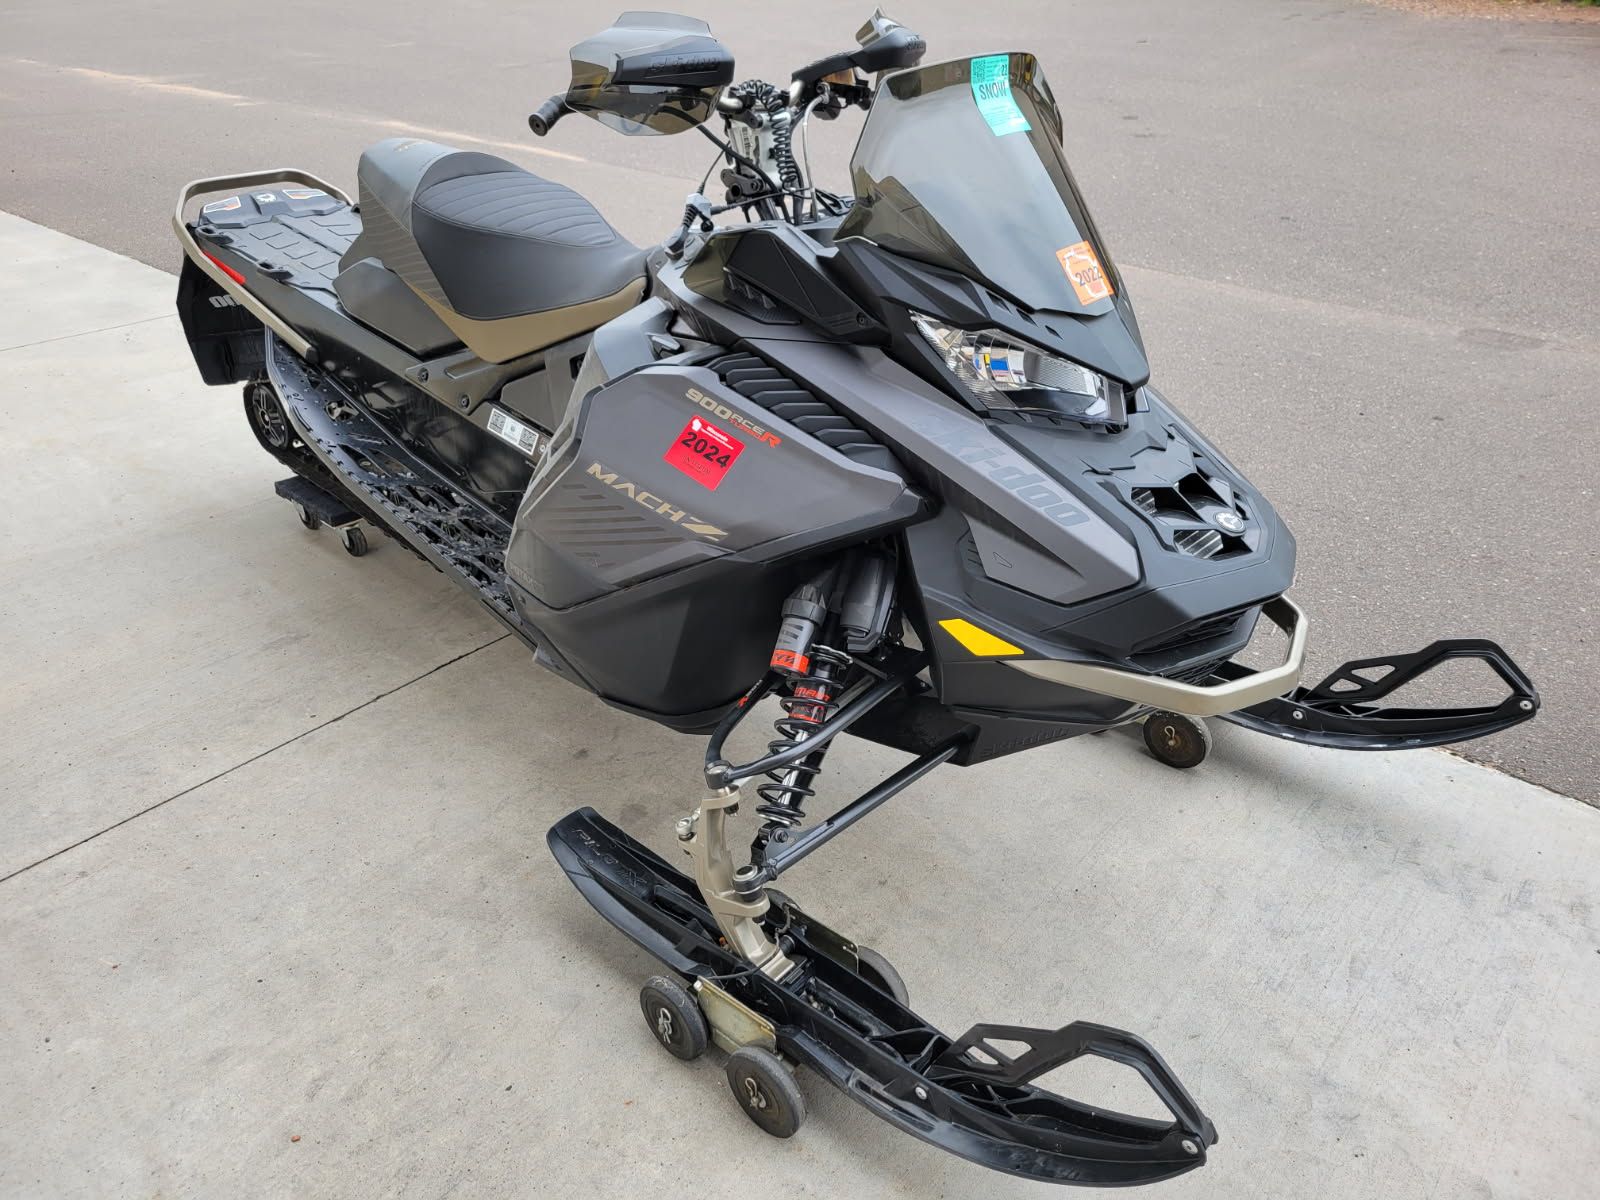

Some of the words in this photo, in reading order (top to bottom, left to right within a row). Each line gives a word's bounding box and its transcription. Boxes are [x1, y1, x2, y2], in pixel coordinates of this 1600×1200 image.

[979, 80, 1007, 101] SNOW
[1075, 267, 1104, 287] 2022
[681, 431, 732, 469] 2024
